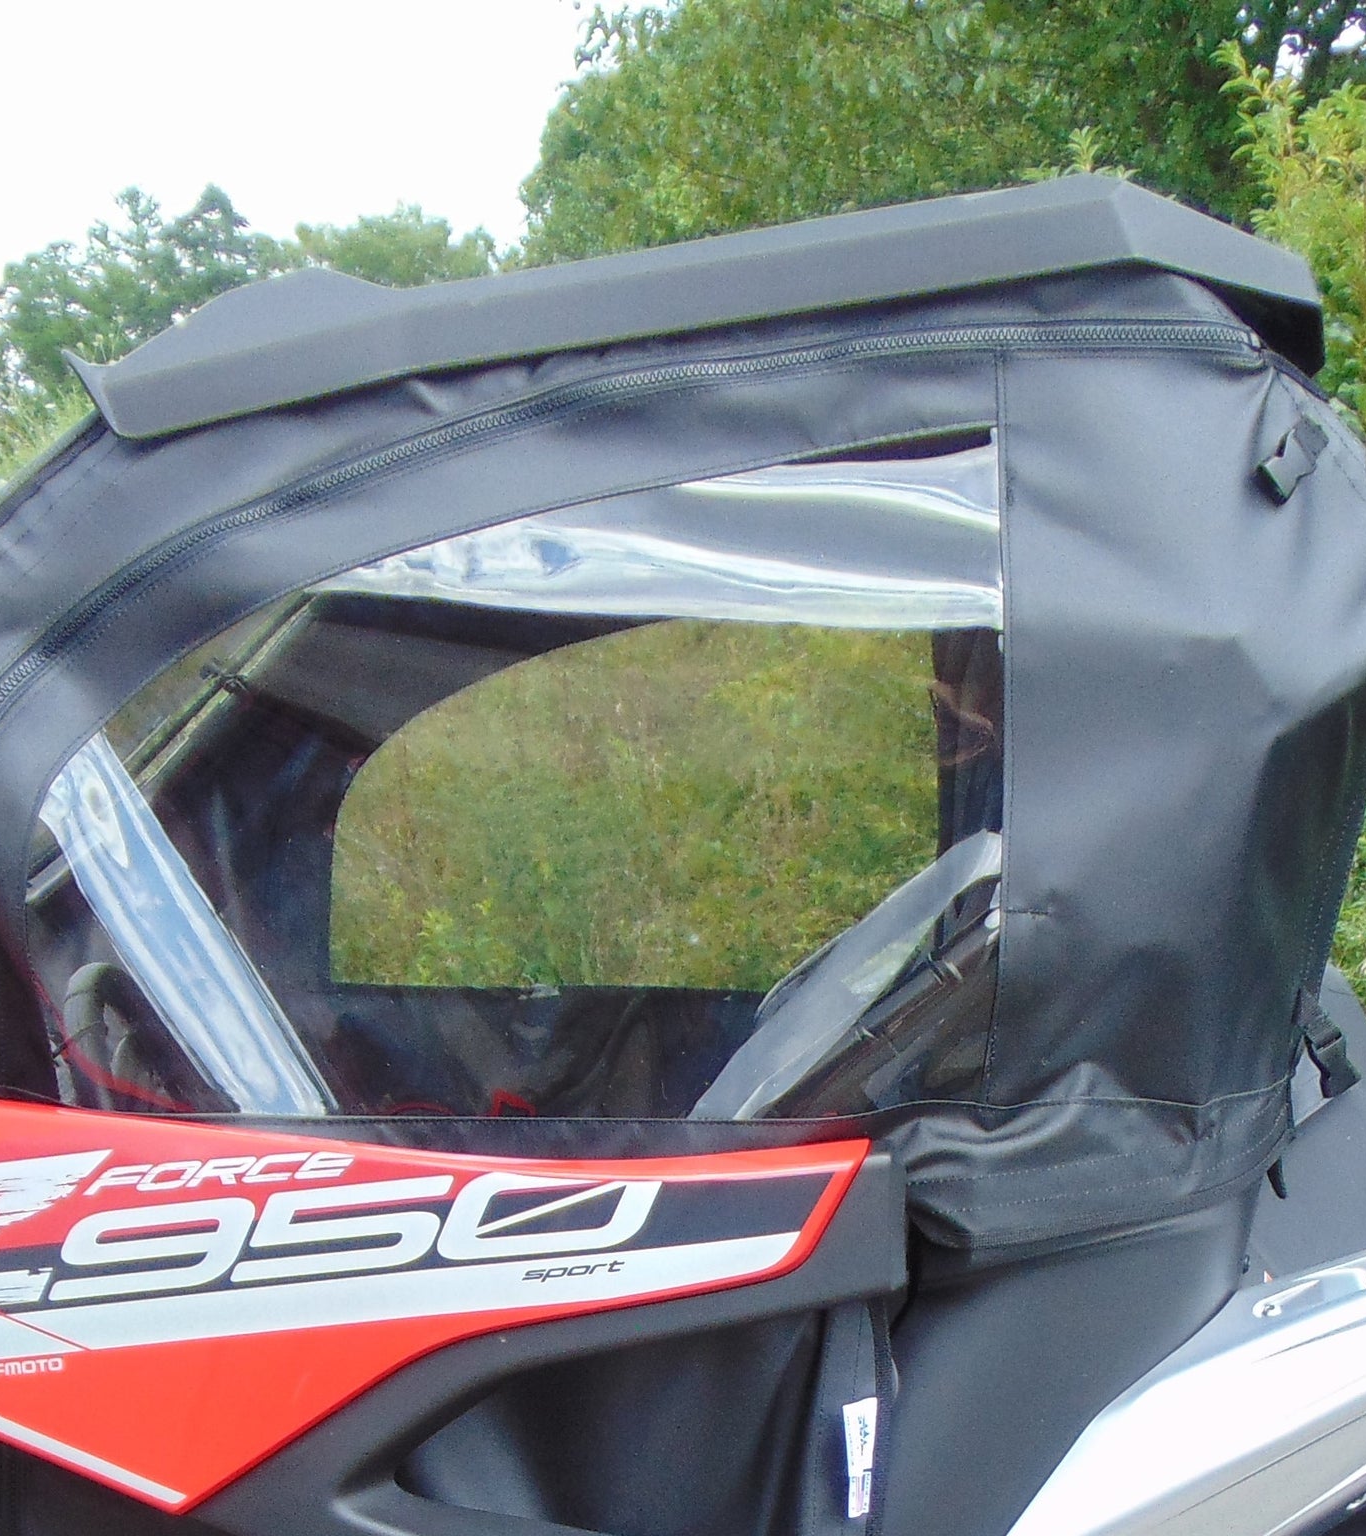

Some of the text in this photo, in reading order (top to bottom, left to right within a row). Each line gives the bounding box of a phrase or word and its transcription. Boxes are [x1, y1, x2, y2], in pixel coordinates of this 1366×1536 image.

[82, 1151, 356, 1197] FORCE
[49, 1172, 662, 1301] 950
[522, 1260, 625, 1282] sport
